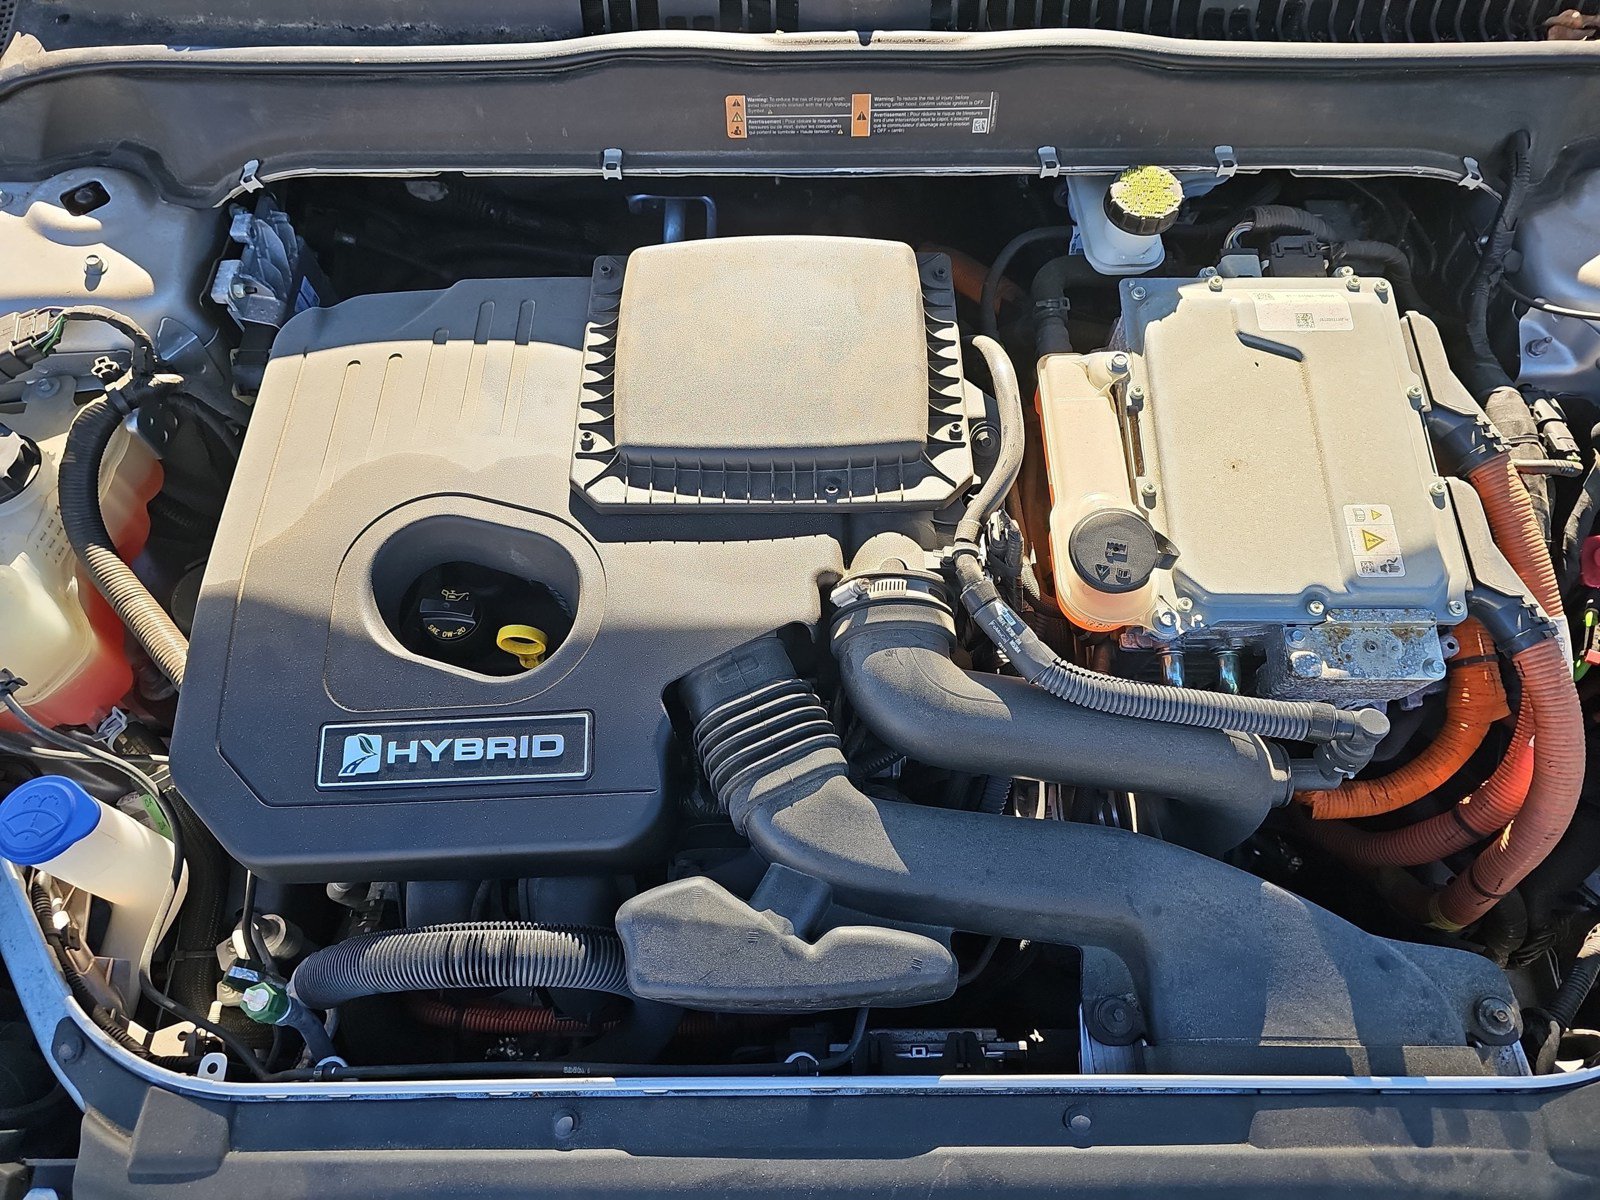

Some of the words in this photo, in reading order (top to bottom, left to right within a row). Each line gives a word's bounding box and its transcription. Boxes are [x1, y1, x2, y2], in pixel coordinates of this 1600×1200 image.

[428, 624, 440, 636] SAE
[442, 626, 466, 638] 0W-20
[386, 734, 565, 764] HYBRID
